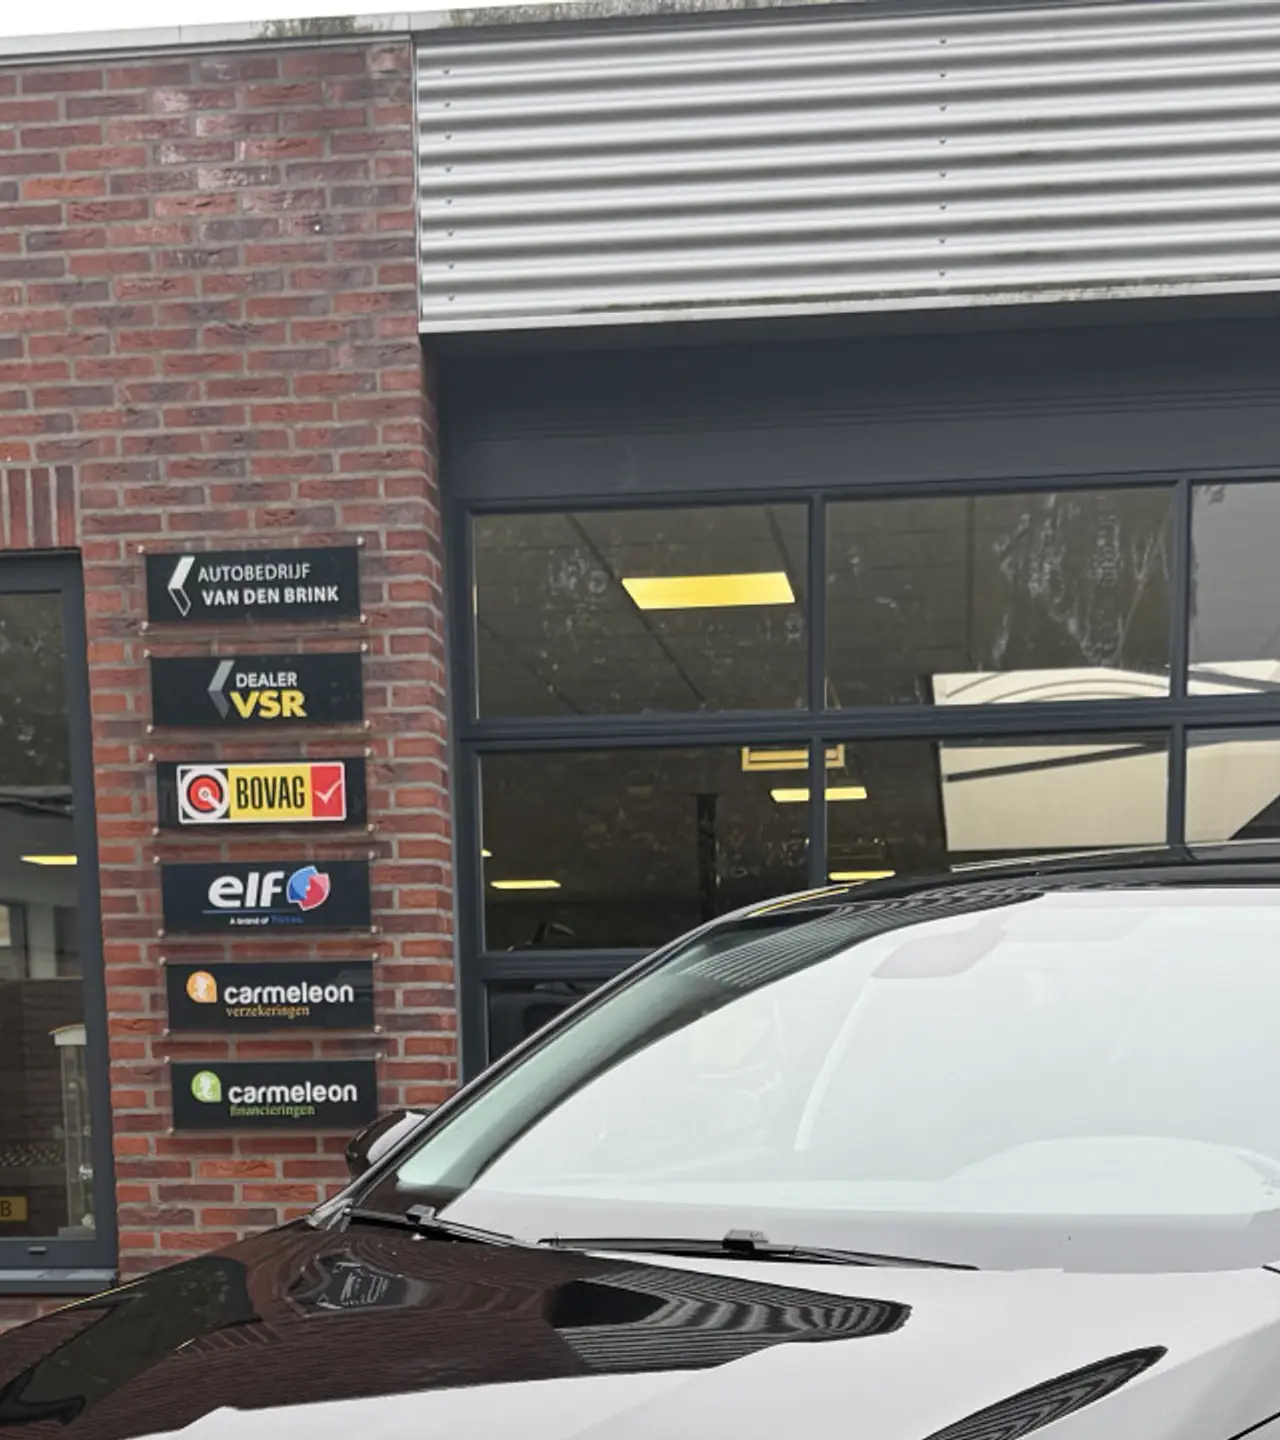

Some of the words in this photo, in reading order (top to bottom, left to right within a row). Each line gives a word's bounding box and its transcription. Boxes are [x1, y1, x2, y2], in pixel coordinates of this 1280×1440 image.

[198, 563, 311, 583] AUTOBEDRIJF
[202, 589, 239, 606] VAN
[243, 588, 279, 605] DEN
[284, 586, 340, 604] BRINK
[236, 672, 297, 688] DEALER
[230, 690, 307, 718] VSR
[236, 775, 305, 810] BOVAG
[208, 871, 285, 908] elf
[224, 981, 354, 1004] carmeleon
[226, 1005, 310, 1019] verzekeringen
[228, 1081, 358, 1104] carmeleon
[230, 1105, 316, 1118] financieringen
